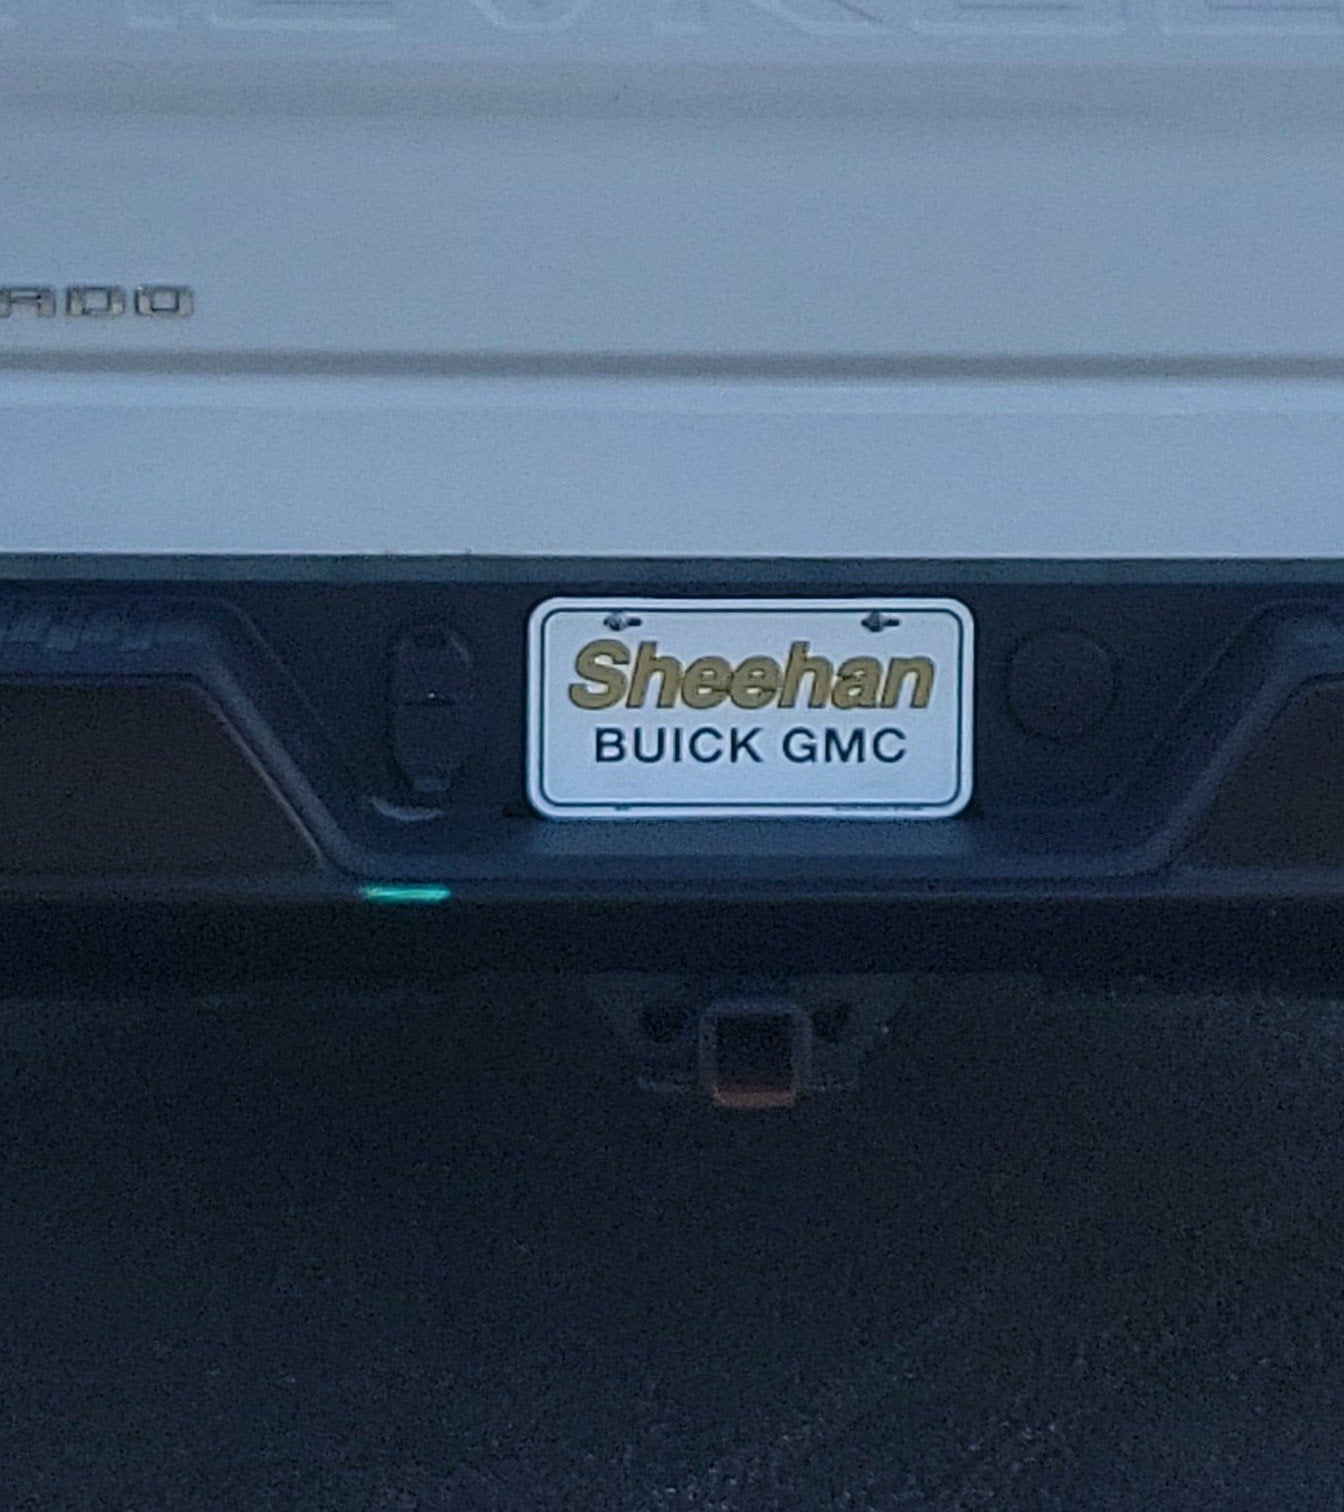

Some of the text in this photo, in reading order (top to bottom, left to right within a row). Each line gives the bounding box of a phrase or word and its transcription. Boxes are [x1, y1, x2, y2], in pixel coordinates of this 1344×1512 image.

[567, 638, 936, 710] Sheehan
[594, 726, 907, 764] BUICK GMC
